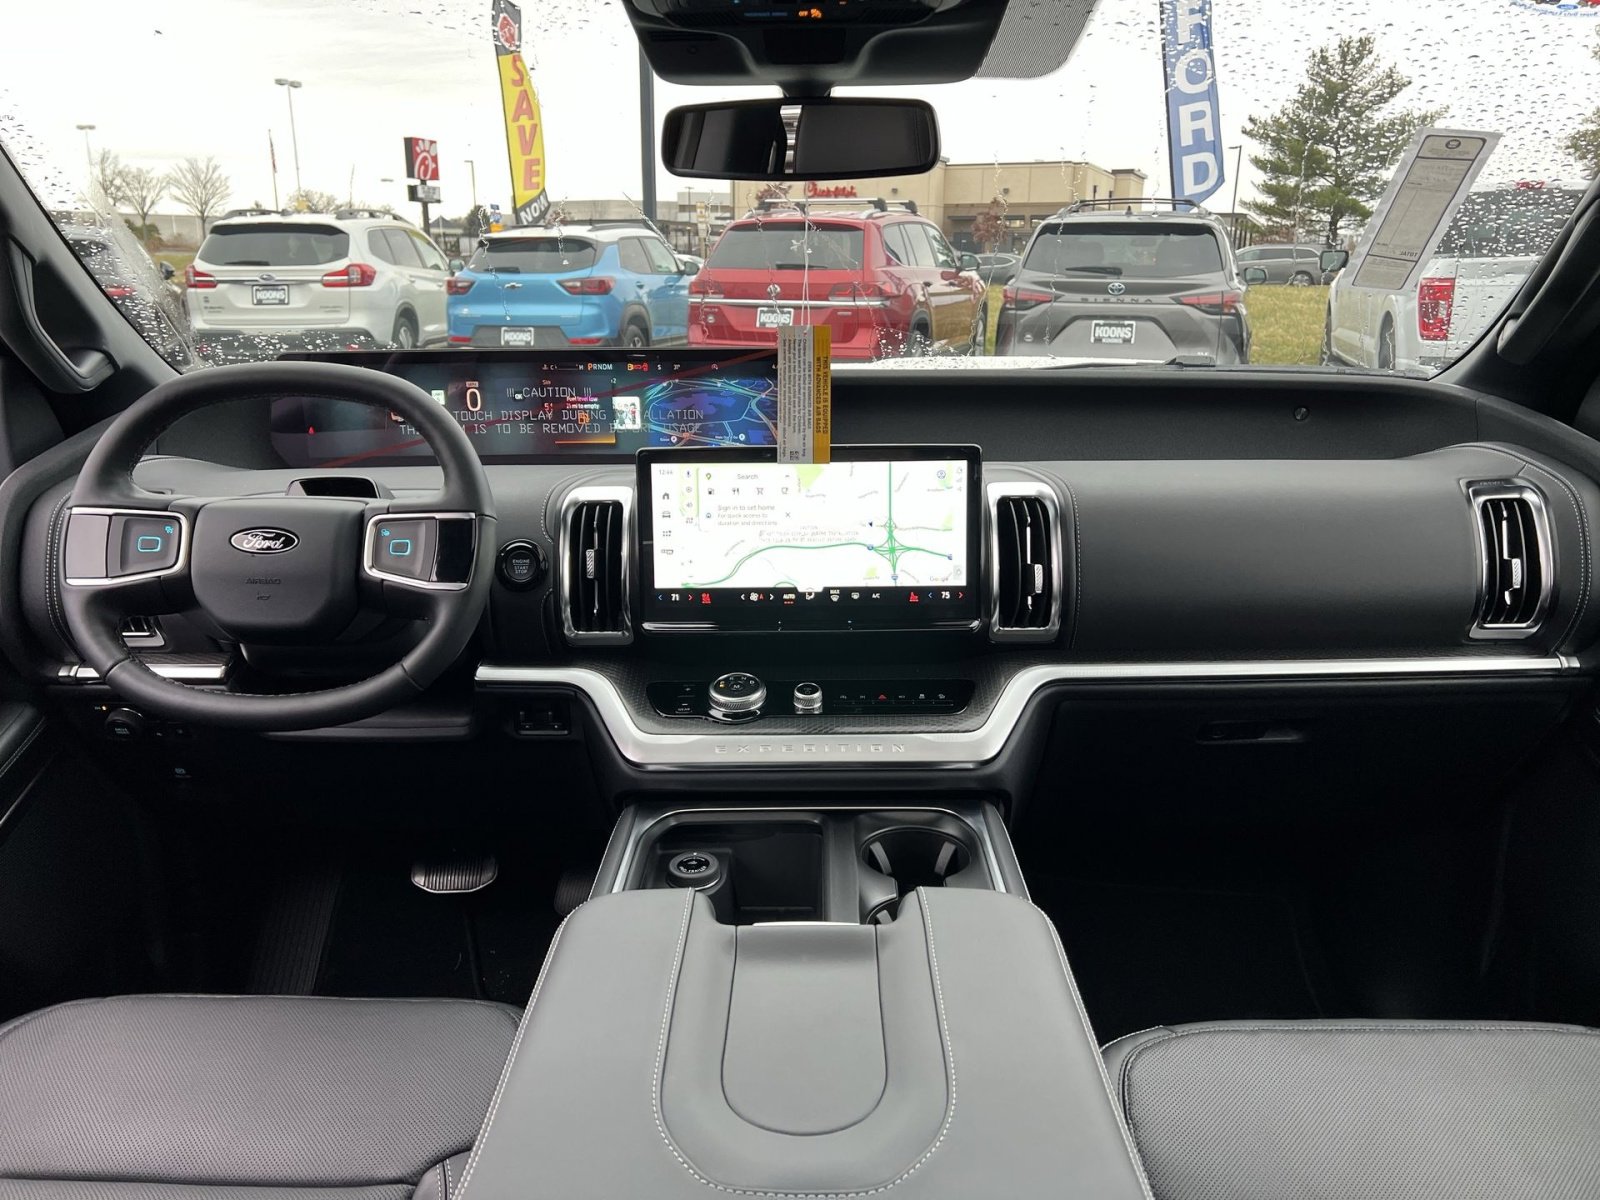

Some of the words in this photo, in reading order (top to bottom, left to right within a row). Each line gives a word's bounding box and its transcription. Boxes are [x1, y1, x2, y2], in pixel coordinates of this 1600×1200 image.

[1175, 0, 1219, 196] FORD
[510, 53, 541, 191] SAVE
[519, 192, 549, 225] NOW
[256, 288, 286, 300] KOONS
[759, 312, 791, 324] KOONS
[504, 331, 531, 342] KOONS
[1095, 326, 1132, 338] KOONS
[587, 363, 613, 371] PRNDM
[522, 387, 576, 398] CAUTION
[466, 388, 481, 411] 0
[453, 410, 493, 421] TOUCH
[501, 410, 553, 420] DISPLAY
[474, 424, 487, 434] IS
[496, 424, 511, 434] TO
[520, 424, 535, 434] BE
[542, 423, 601, 434] REMOVED
[737, 473, 759, 481] Search
[718, 504, 731, 512] Sign
[243, 531, 286, 549] Ford
[671, 593, 680, 601] 71
[941, 591, 950, 599] 75
[714, 743, 905, 754] EXPEDITION
